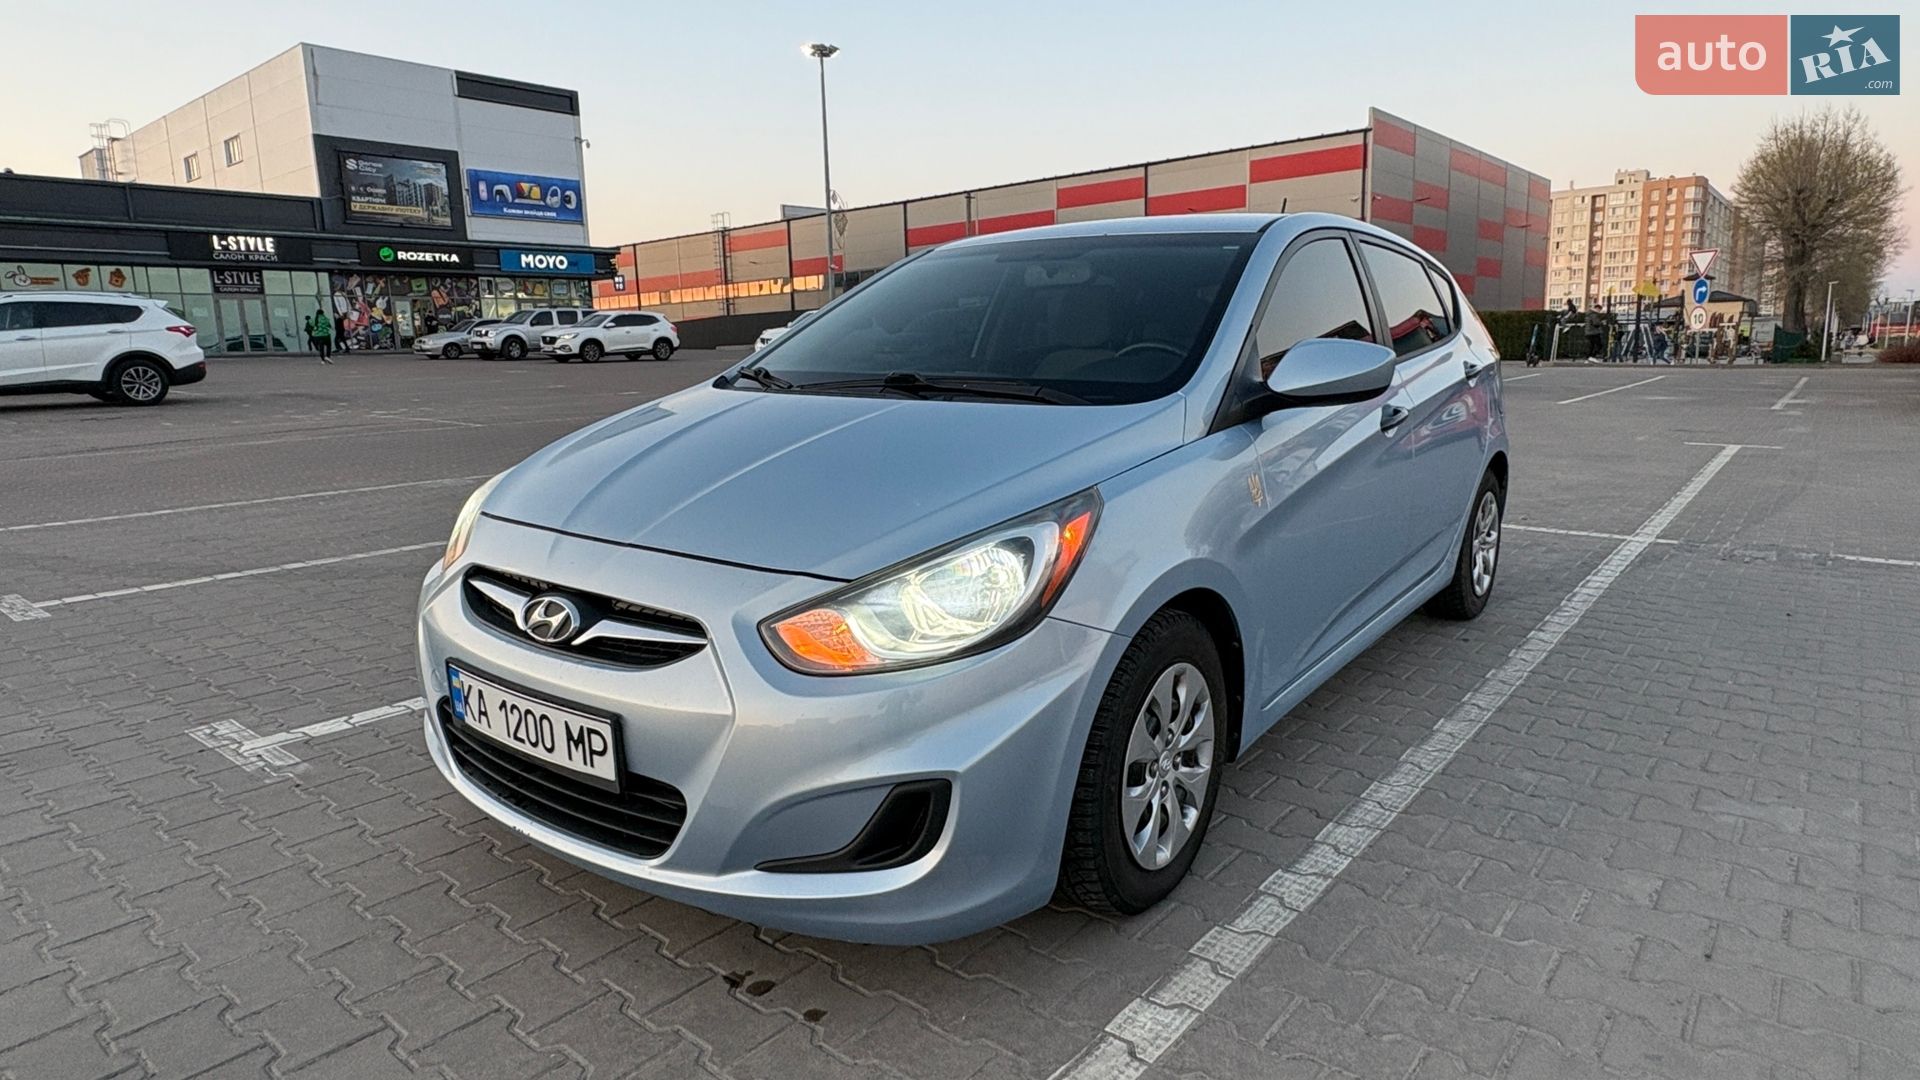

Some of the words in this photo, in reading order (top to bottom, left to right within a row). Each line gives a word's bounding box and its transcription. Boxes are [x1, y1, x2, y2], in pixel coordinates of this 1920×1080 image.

[212, 234, 275, 252] L-STYLE
[397, 251, 460, 263] ROZETKA
[520, 254, 568, 269] MOYO
[213, 270, 261, 284] L-STYLE
[1694, 313, 1704, 324] 10
[460, 680, 491, 729] KA
[498, 699, 555, 754] 1200
[564, 720, 608, 768] MP
